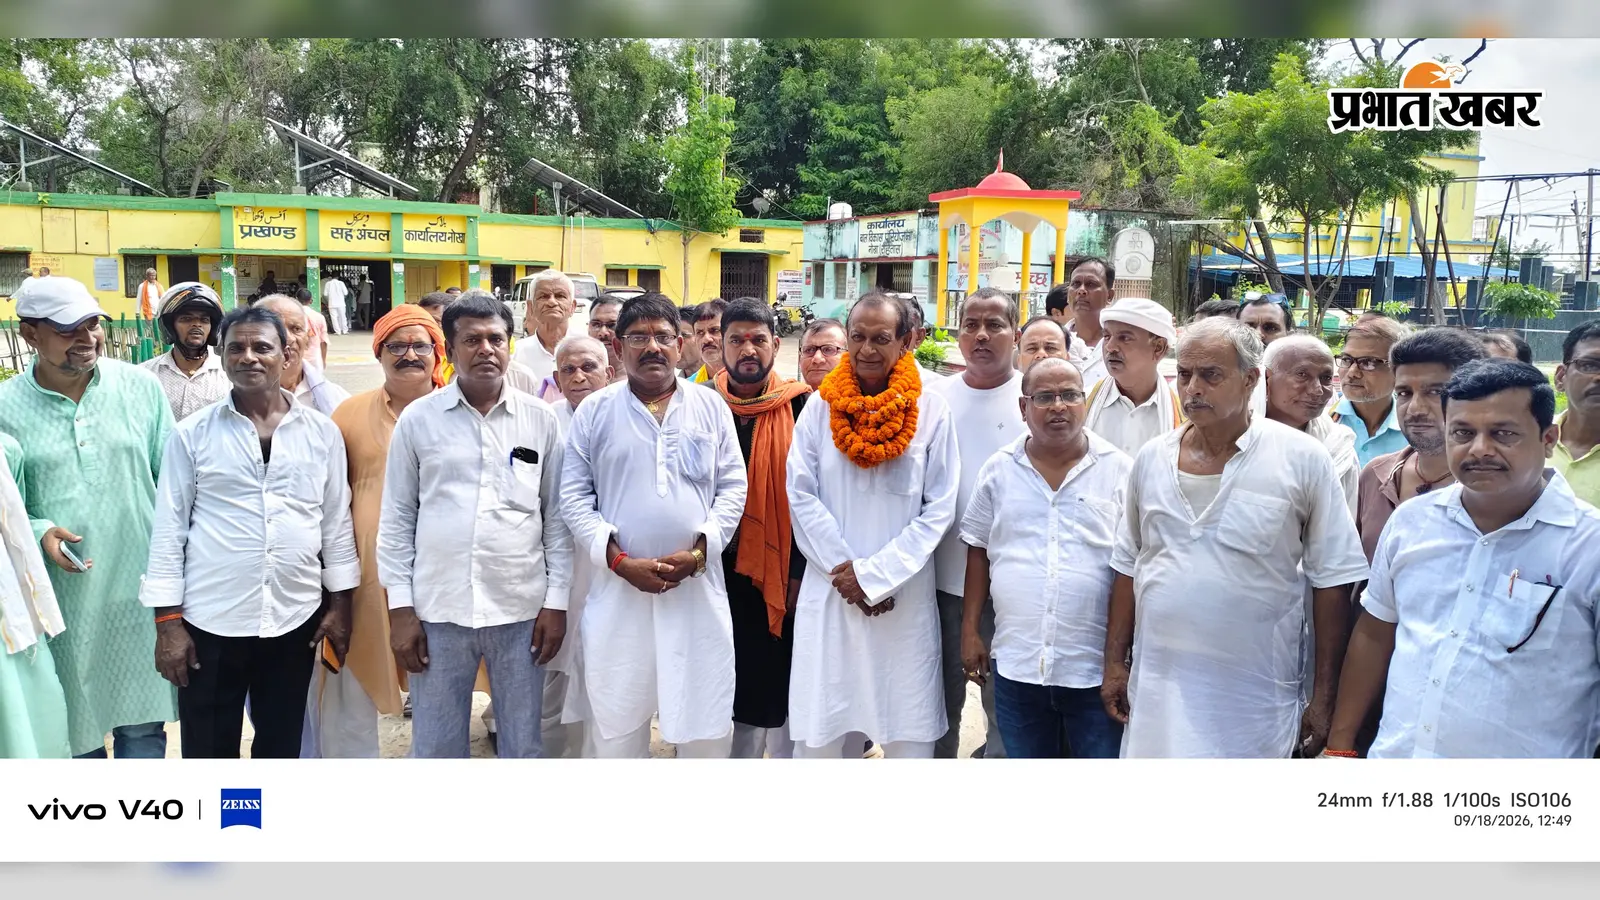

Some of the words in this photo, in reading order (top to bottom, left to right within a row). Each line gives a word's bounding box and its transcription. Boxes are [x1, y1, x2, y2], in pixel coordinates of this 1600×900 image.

[238, 224, 297, 240] प्रखण्ड
[866, 218, 906, 230] कार्यालय
[330, 227, 353, 242] सह
[356, 223, 391, 241] अंचल
[403, 227, 447, 243] कार्यालय
[447, 229, 466, 244] नोखा
